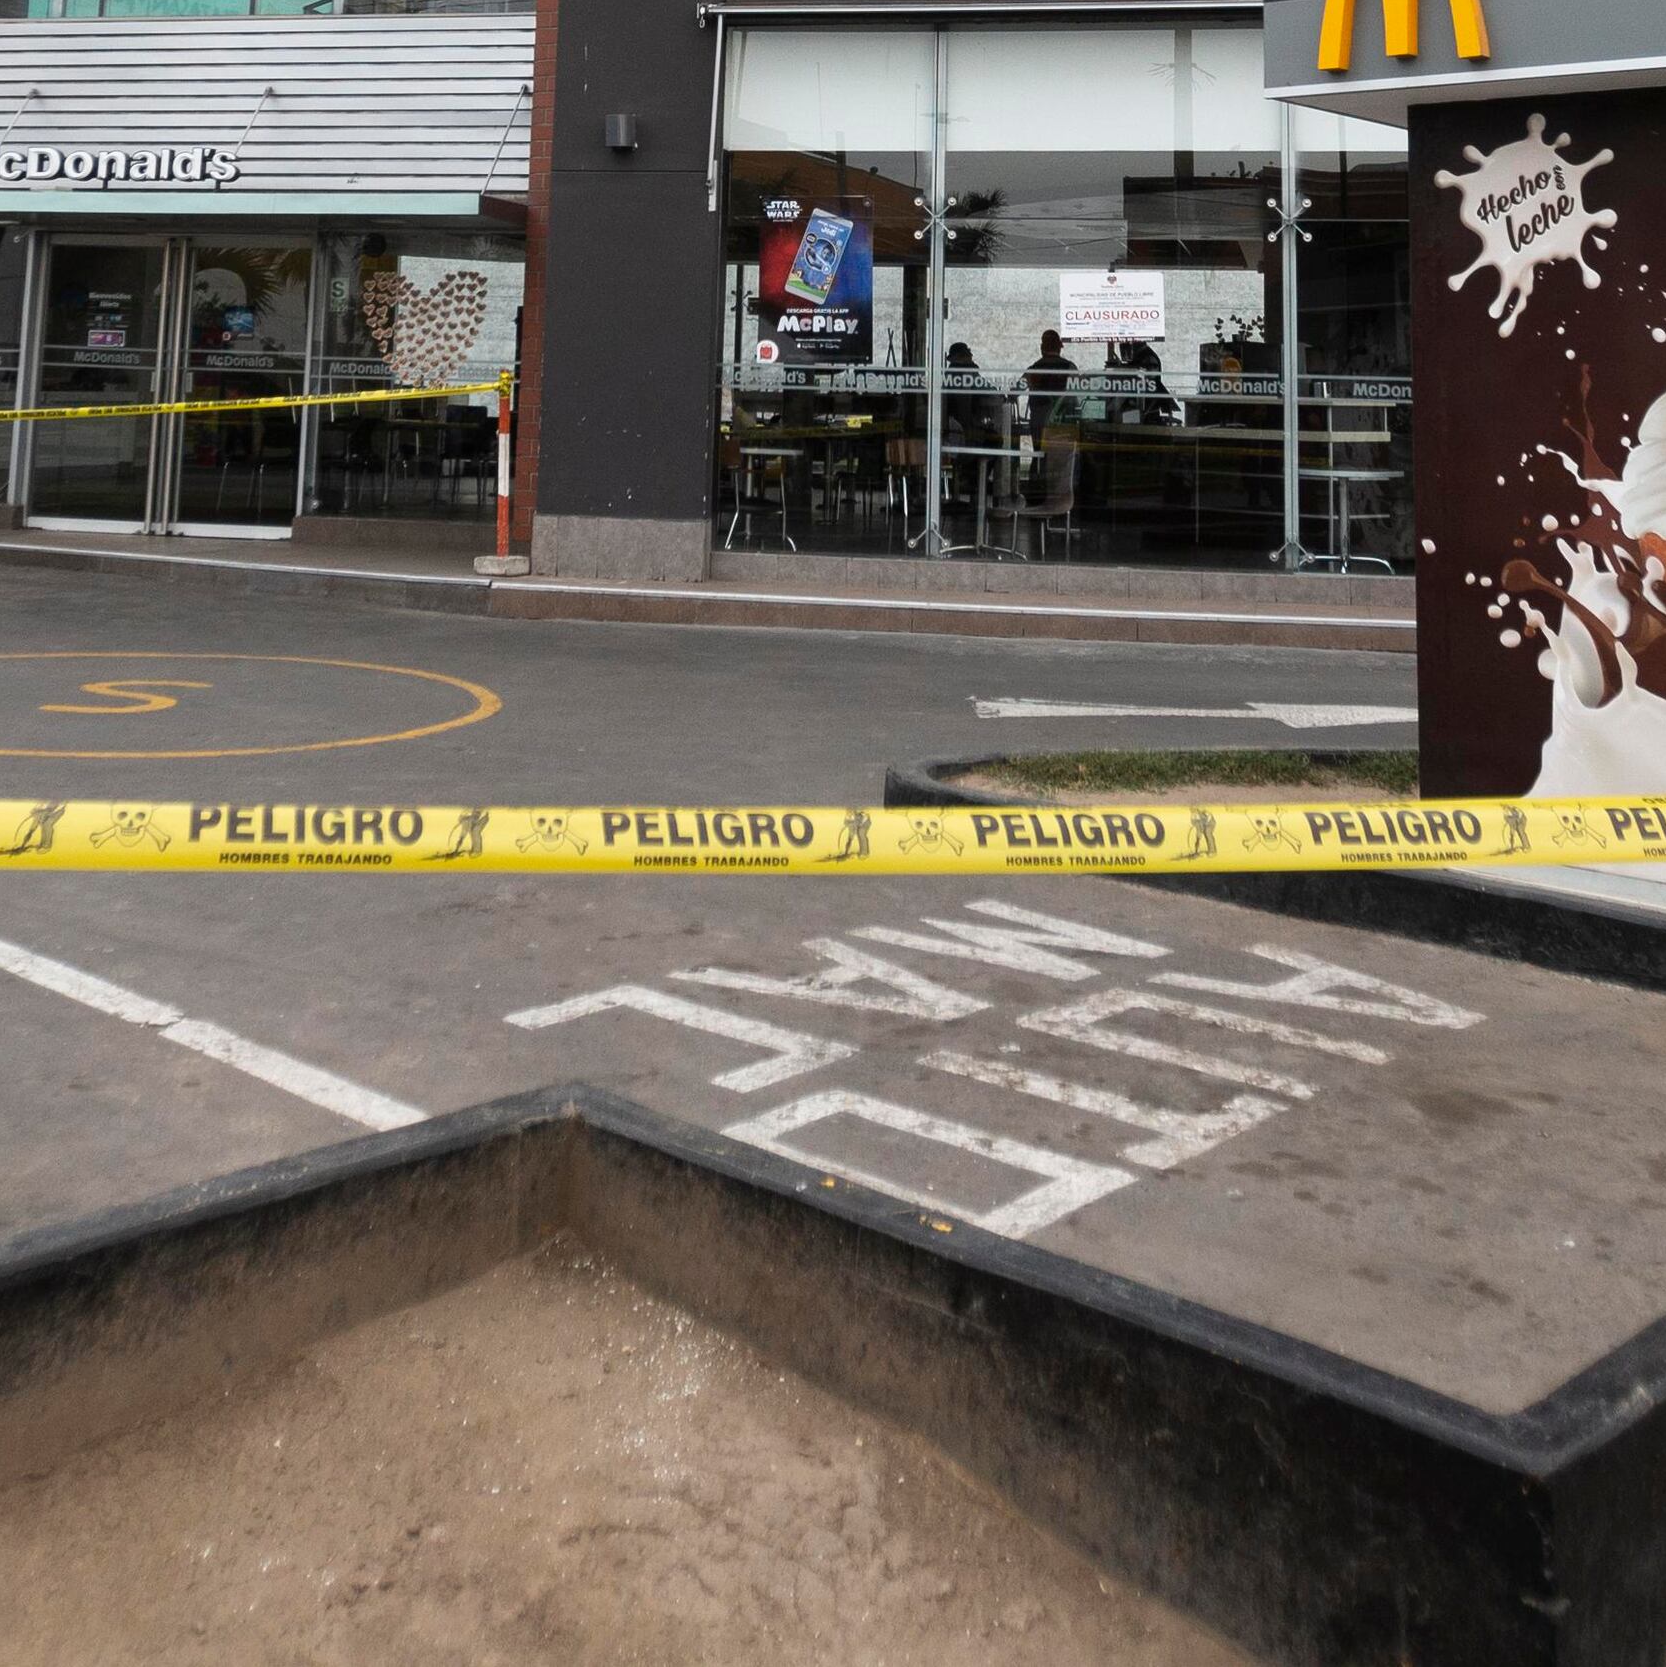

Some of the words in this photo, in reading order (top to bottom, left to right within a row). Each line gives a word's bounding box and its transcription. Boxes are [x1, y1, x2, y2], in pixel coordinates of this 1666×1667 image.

[766, 200, 800, 209] STAR
[1477, 170, 1552, 224] Hecho
[766, 211, 800, 219] WARS
[1505, 194, 1575, 253] leche
[1065, 310, 1160, 321] CLAUSURADO
[777, 315, 859, 335] McPlay
[73, 352, 141, 365] McDonald's
[206, 354, 275, 368] McDonald's
[1065, 375, 1157, 392] McDonald's
[1197, 378, 1285, 394] McDonald's
[188, 806, 426, 847] PELIGRO
[600, 809, 816, 849] PELIGRO
[970, 812, 1167, 849] PELIGRO
[1303, 807, 1483, 847] PELIGRO
[218, 851, 290, 866] HOMBRES
[296, 852, 393, 866] TRABAJANDO
[633, 854, 698, 868] HOMBRES
[703, 855, 790, 868] TRABAJANDO
[1006, 855, 1063, 867] HOMBRES
[1068, 855, 1146, 867] TRABAJANDO
[1340, 851, 1393, 864] HOMBRES
[1397, 850, 1468, 863] TRABAJANDO
